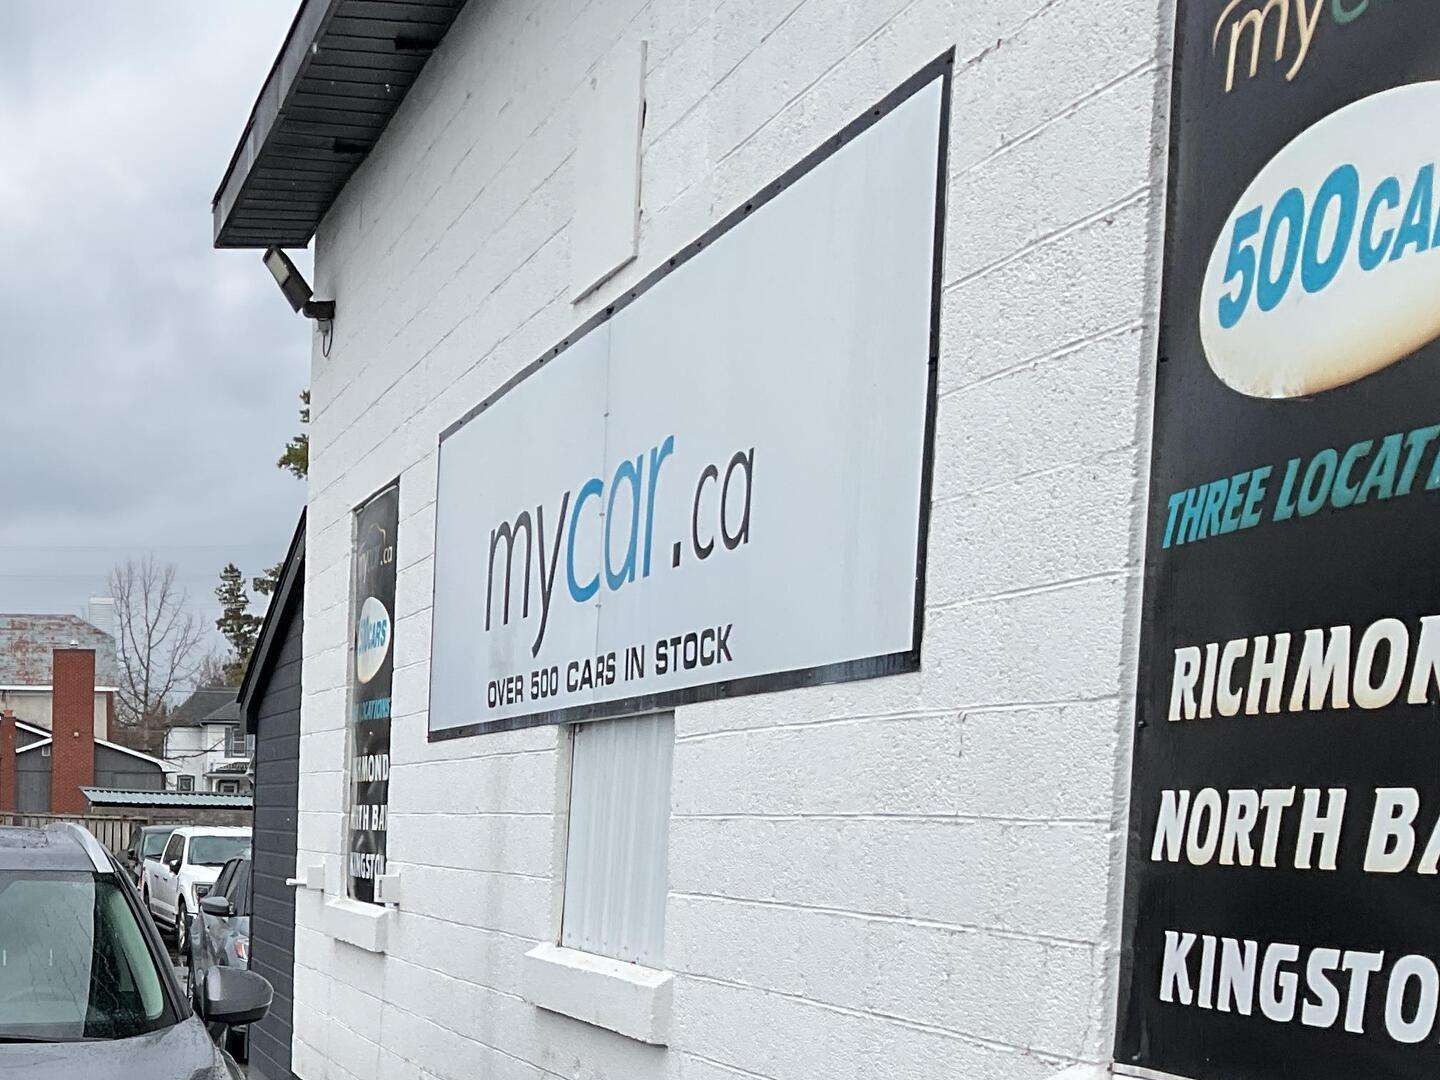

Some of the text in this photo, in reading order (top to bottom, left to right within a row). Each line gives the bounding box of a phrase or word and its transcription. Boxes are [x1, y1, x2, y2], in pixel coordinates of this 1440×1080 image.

[1225, 0, 1368, 92] my
[485, 435, 754, 658] mycar.ca
[1162, 465, 1273, 549] THREE
[488, 623, 733, 708] OVER 500 CARS IN STOCK
[1151, 786, 1347, 870] NORTH
[1159, 930, 1440, 1044] KINGSTO
